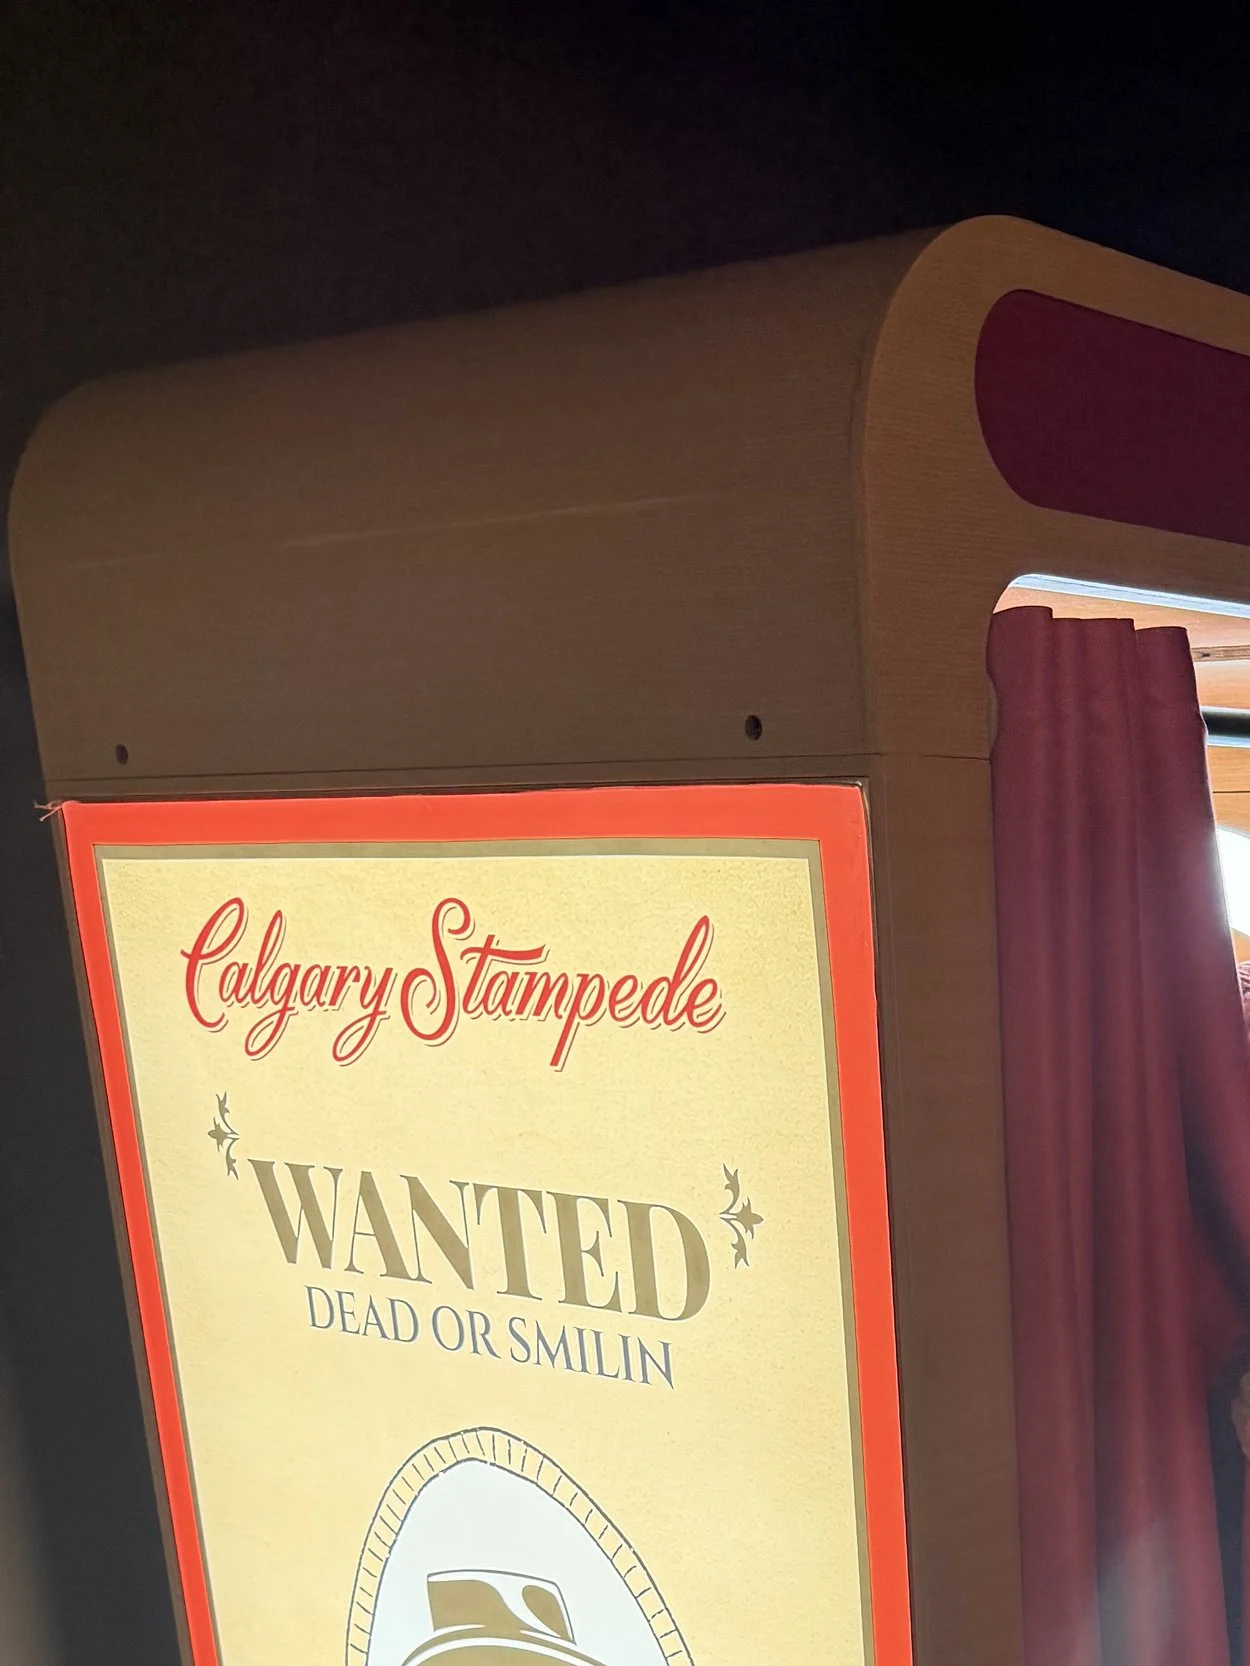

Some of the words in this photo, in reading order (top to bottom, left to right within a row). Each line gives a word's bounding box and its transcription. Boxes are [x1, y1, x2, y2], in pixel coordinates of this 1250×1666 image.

[181, 897, 396, 1066] Calgary
[400, 897, 727, 1071] Stampede
[248, 1158, 711, 1322] WANTED
[304, 1285, 419, 1344] DEAD
[431, 1305, 502, 1359] OR
[509, 1315, 676, 1390] SMILIN
